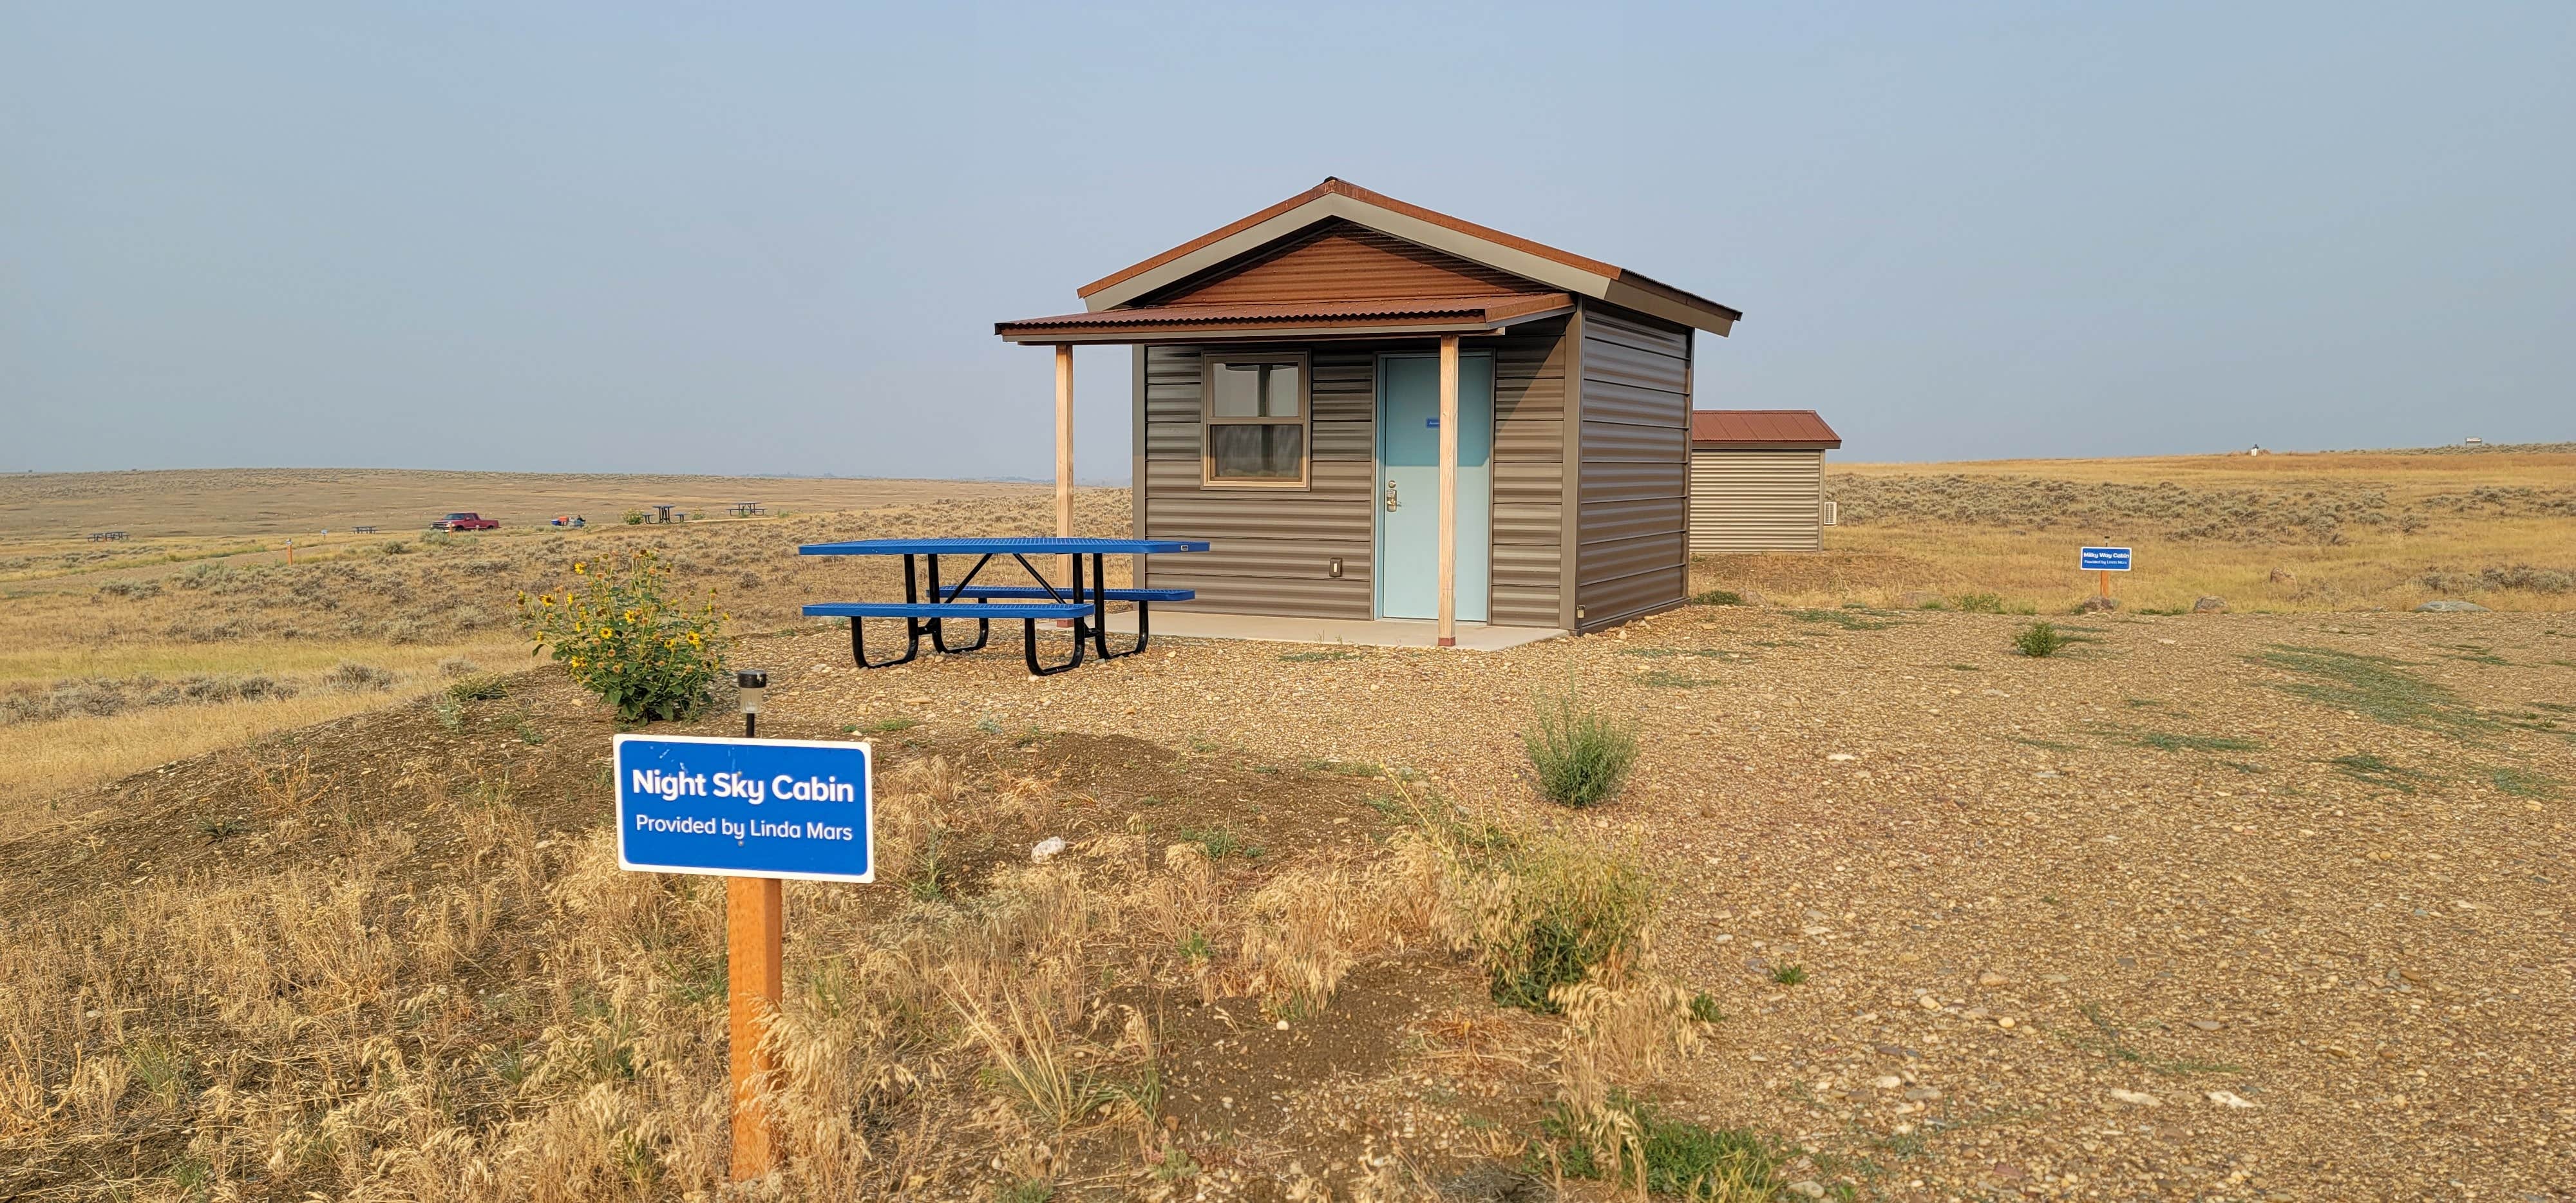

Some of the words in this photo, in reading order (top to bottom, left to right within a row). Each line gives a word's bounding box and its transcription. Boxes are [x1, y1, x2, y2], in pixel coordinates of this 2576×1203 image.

[632, 769, 707, 801] Night
[712, 772, 765, 805] Sky
[772, 775, 854, 802] Cabin
[636, 814, 717, 835] Provided
[721, 819, 745, 840] by
[750, 819, 801, 838] Linda
[806, 822, 853, 841] Mars
